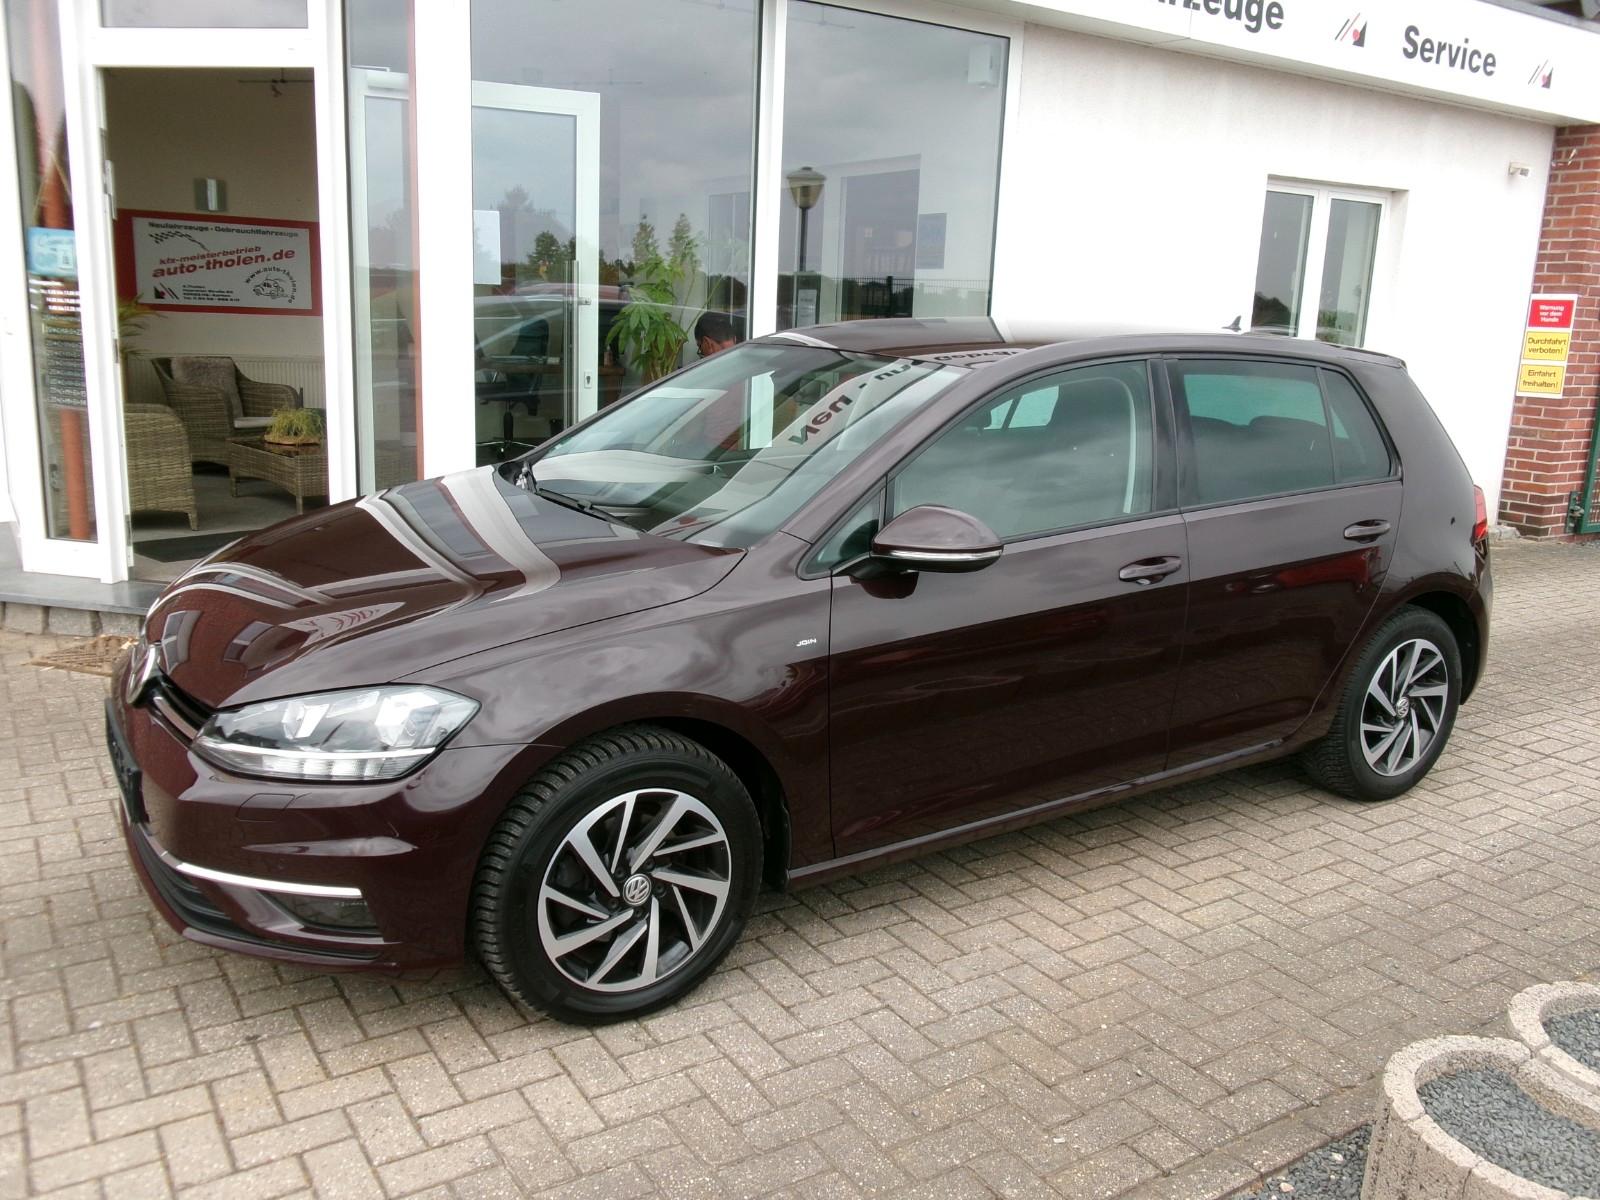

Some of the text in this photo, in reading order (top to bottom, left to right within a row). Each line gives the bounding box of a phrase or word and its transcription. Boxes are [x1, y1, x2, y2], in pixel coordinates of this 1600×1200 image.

[1158, 0, 1284, 33] euge
[1402, 24, 1497, 76] Service
[159, 246, 262, 265] kfz-meisterbetrieb
[152, 249, 296, 278] auto-tholen.de
[1528, 337, 1567, 346] Durchfahrt
[1528, 369, 1557, 378] Einfahrt
[1522, 379, 1559, 388] freihalten!
[796, 638, 817, 647] JOIN
